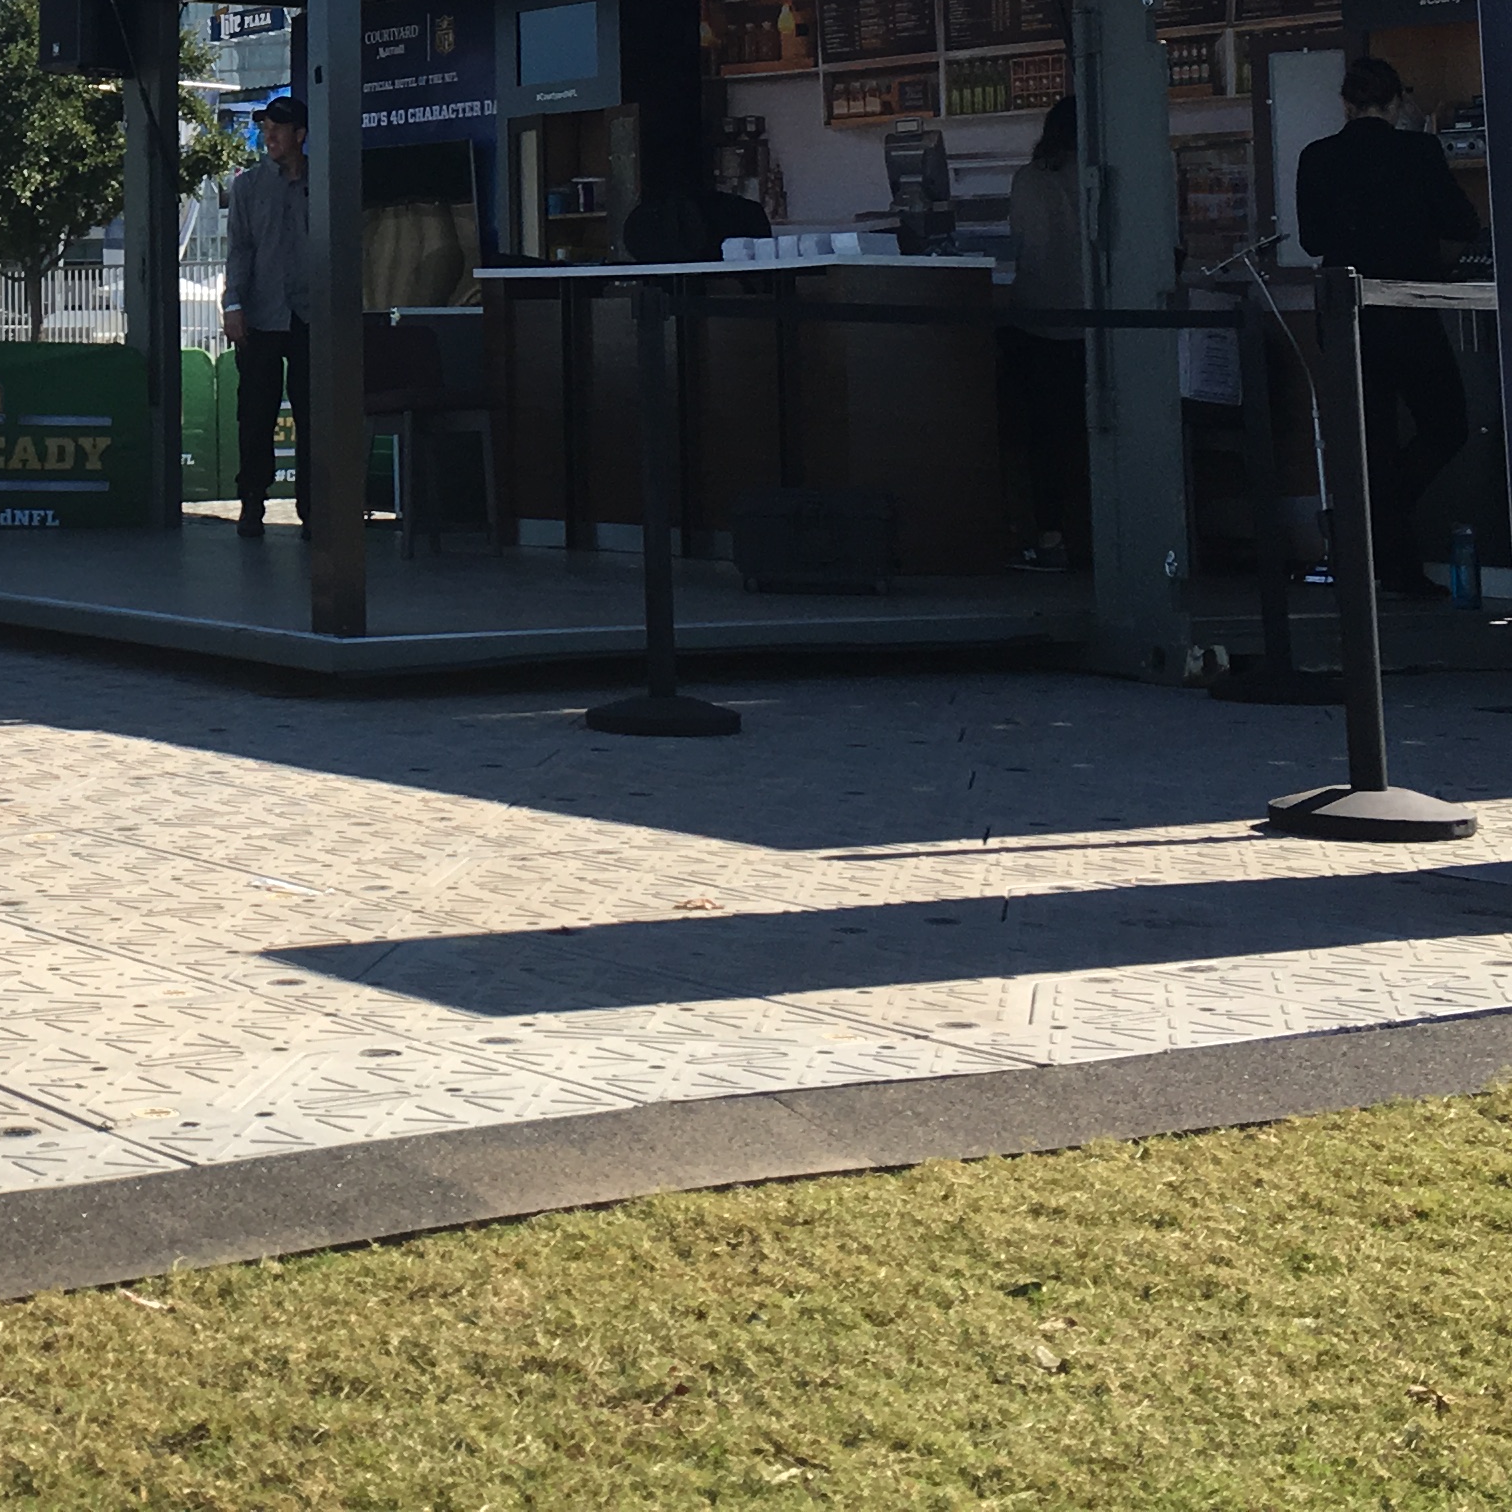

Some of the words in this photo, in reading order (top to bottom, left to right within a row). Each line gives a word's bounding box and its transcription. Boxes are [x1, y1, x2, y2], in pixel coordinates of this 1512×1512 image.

[244, 12, 271, 28] PLAZA
[365, 25, 419, 44] COURTYARD
[363, 80, 393, 92] OFFICIAL
[394, 77, 417, 89] HOTEL
[418, 75, 427, 85] OF
[428, 73, 442, 84] THE
[361, 111, 388, 128] RD'S
[390, 109, 405, 125] 40
[408, 101, 481, 123] CHARACTER
